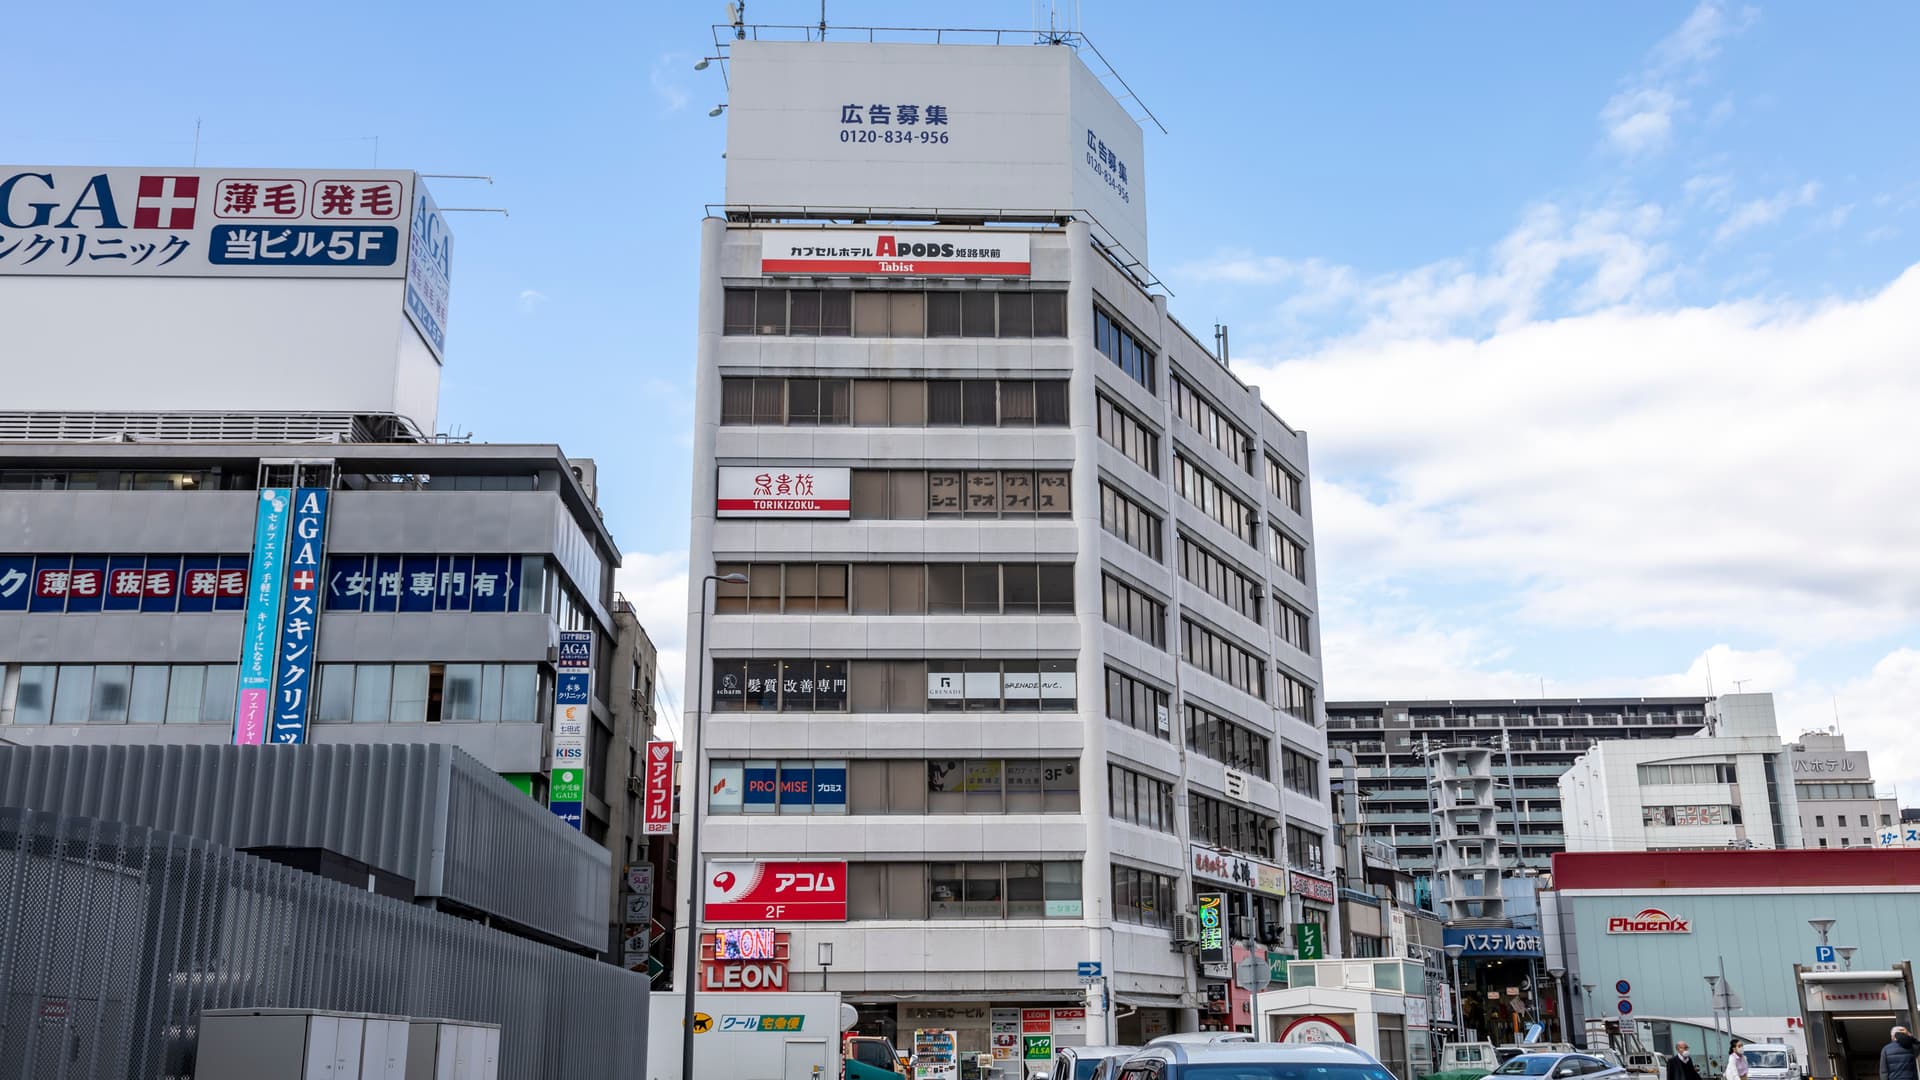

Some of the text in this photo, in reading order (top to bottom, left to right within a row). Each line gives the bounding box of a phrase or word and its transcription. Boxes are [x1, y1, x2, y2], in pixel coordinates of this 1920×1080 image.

[840, 104, 949, 126] 広告募集
[839, 130, 950, 144] 0120-834-956
[1086, 128, 1128, 186] 広告募集
[222, 182, 297, 215] 薄毛
[321, 184, 394, 216] 発毛
[224, 228, 385, 261] 当ビル5F
[413, 195, 449, 282] AGA
[790, 235, 1001, 258] カプセルホテル APODS 姫路駅前
[878, 261, 914, 272] Tabist
[753, 473, 814, 496] 鳥貴族
[752, 500, 815, 510] TORIKIZOKU
[294, 492, 321, 565] AGA
[263, 513, 278, 570] セルフエステ
[0, 568, 28, 595] ク
[42, 572, 97, 595] 薄毛
[115, 572, 171, 595] 抜毛
[191, 572, 244, 595] 発毛
[560, 643, 589, 655] AGA
[747, 678, 847, 693] 髪質改善専門
[244, 692, 259, 744] フェイシャ
[556, 748, 582, 758] KISS
[1044, 768, 1062, 781] 3F
[555, 791, 578, 799] GAUS
[650, 761, 668, 820] アイフル
[749, 780, 808, 792] PROMISE
[817, 783, 842, 792] プロミス
[648, 823, 668, 833] B2F
[774, 872, 835, 893] アコム
[765, 905, 786, 920] 2F
[1609, 917, 1689, 931] Phoenix
[1303, 926, 1315, 956] レイク
[1820, 947, 1831, 961] P
[706, 964, 783, 989] LEON
[1026, 1011, 1046, 1019] LEON
[1029, 1038, 1050, 1047] レイク
[1029, 1046, 1050, 1055] ALSA
